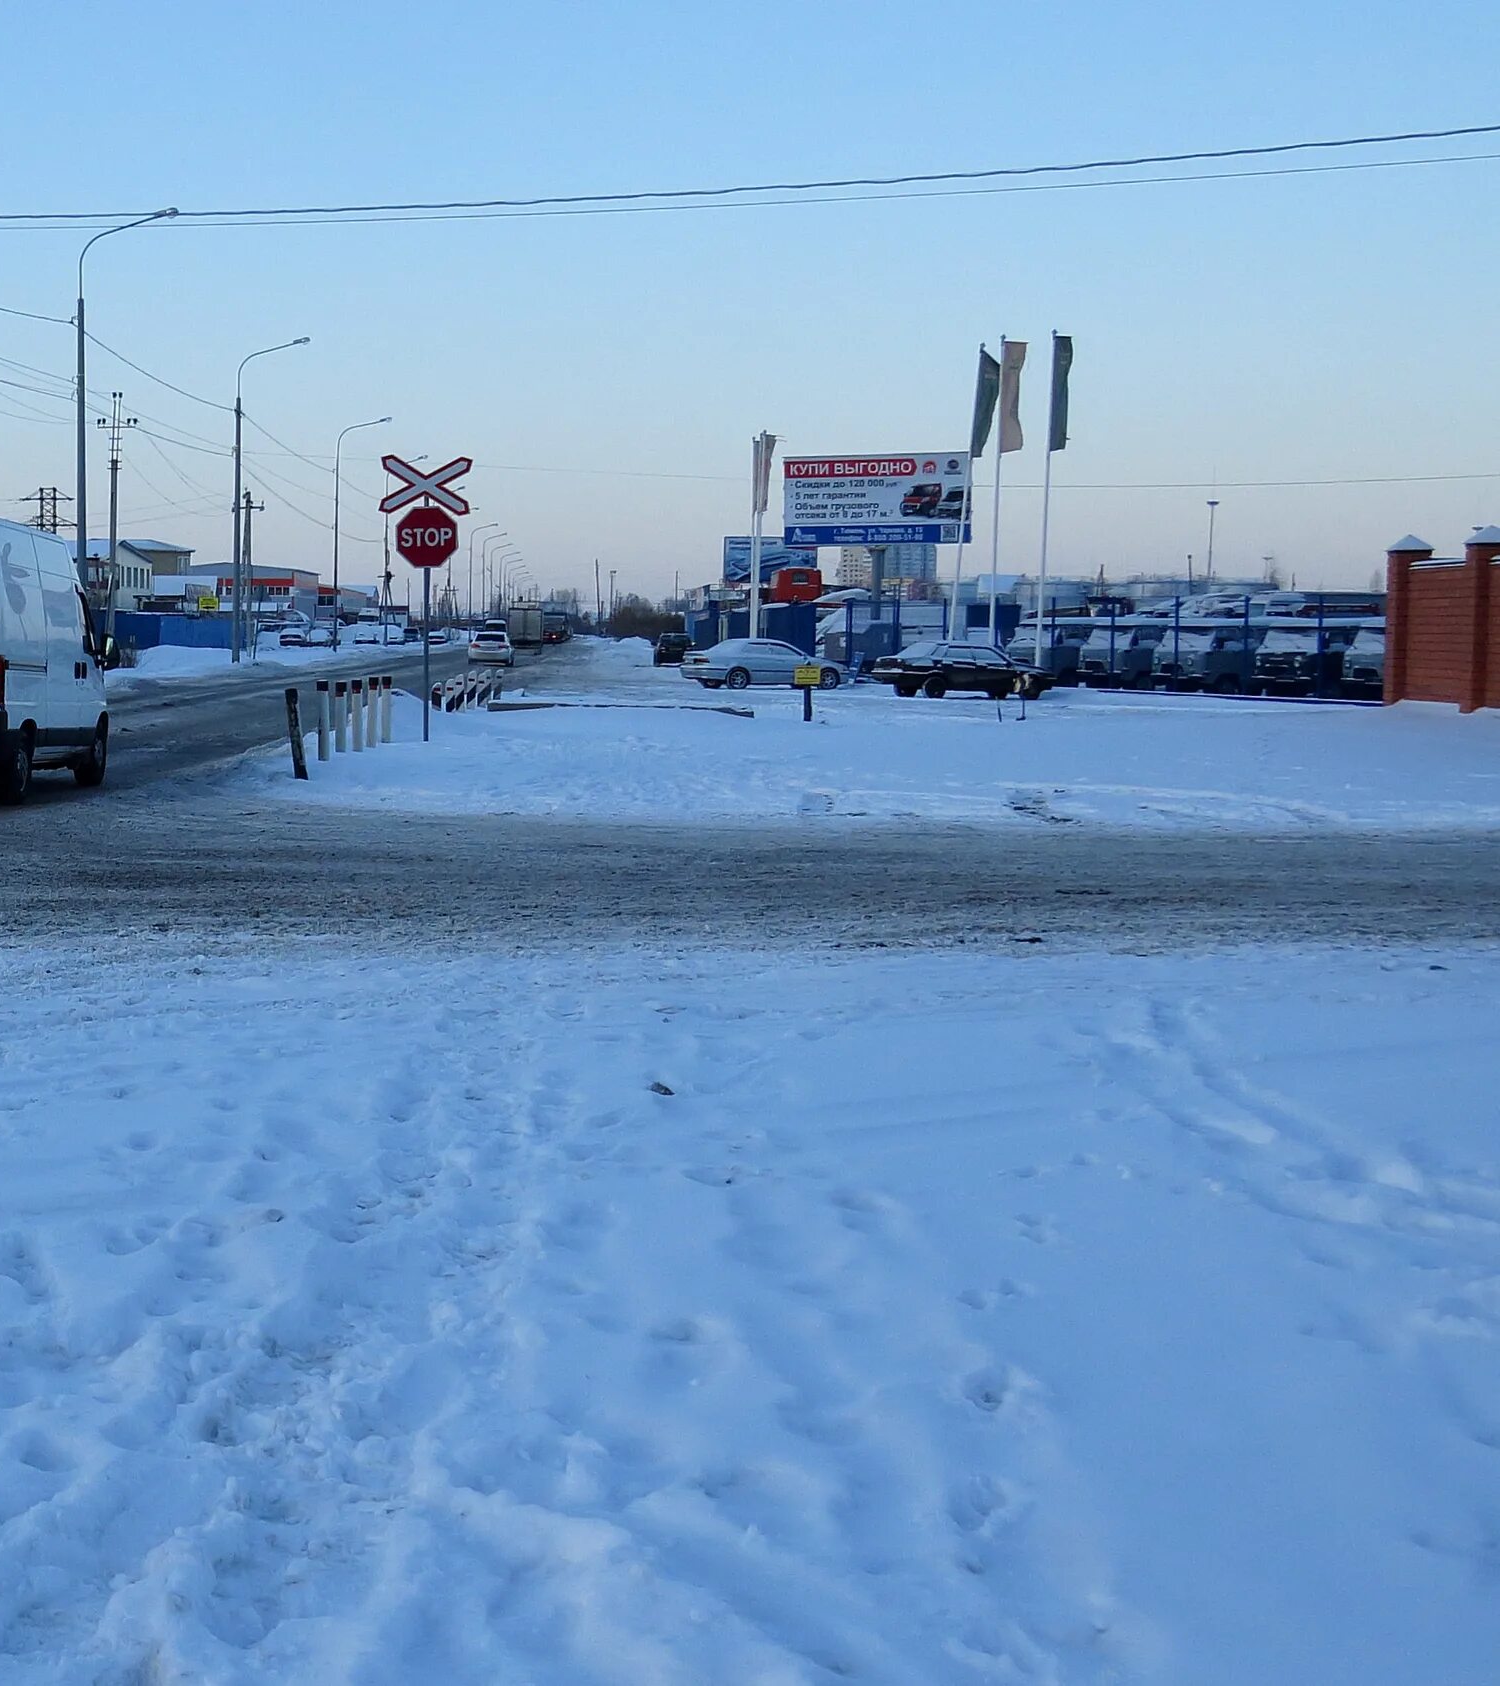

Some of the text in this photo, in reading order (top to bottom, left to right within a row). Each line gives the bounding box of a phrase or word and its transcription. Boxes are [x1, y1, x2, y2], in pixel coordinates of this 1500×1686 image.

[790, 463, 829, 475] КУПИ
[834, 461, 912, 475] ВЫГОДНО
[795, 480, 830, 489] Скидки
[832, 481, 845, 489] до
[849, 480, 865, 488] 120
[867, 479, 885, 487] 000
[795, 492, 866, 501] 5 лет гарантии
[794, 502, 879, 512] Объем грузового
[794, 511, 827, 519] отсека
[829, 511, 840, 519] от
[850, 511, 863, 519] до
[866, 509, 878, 518] 17
[401, 527, 453, 547] STOP
